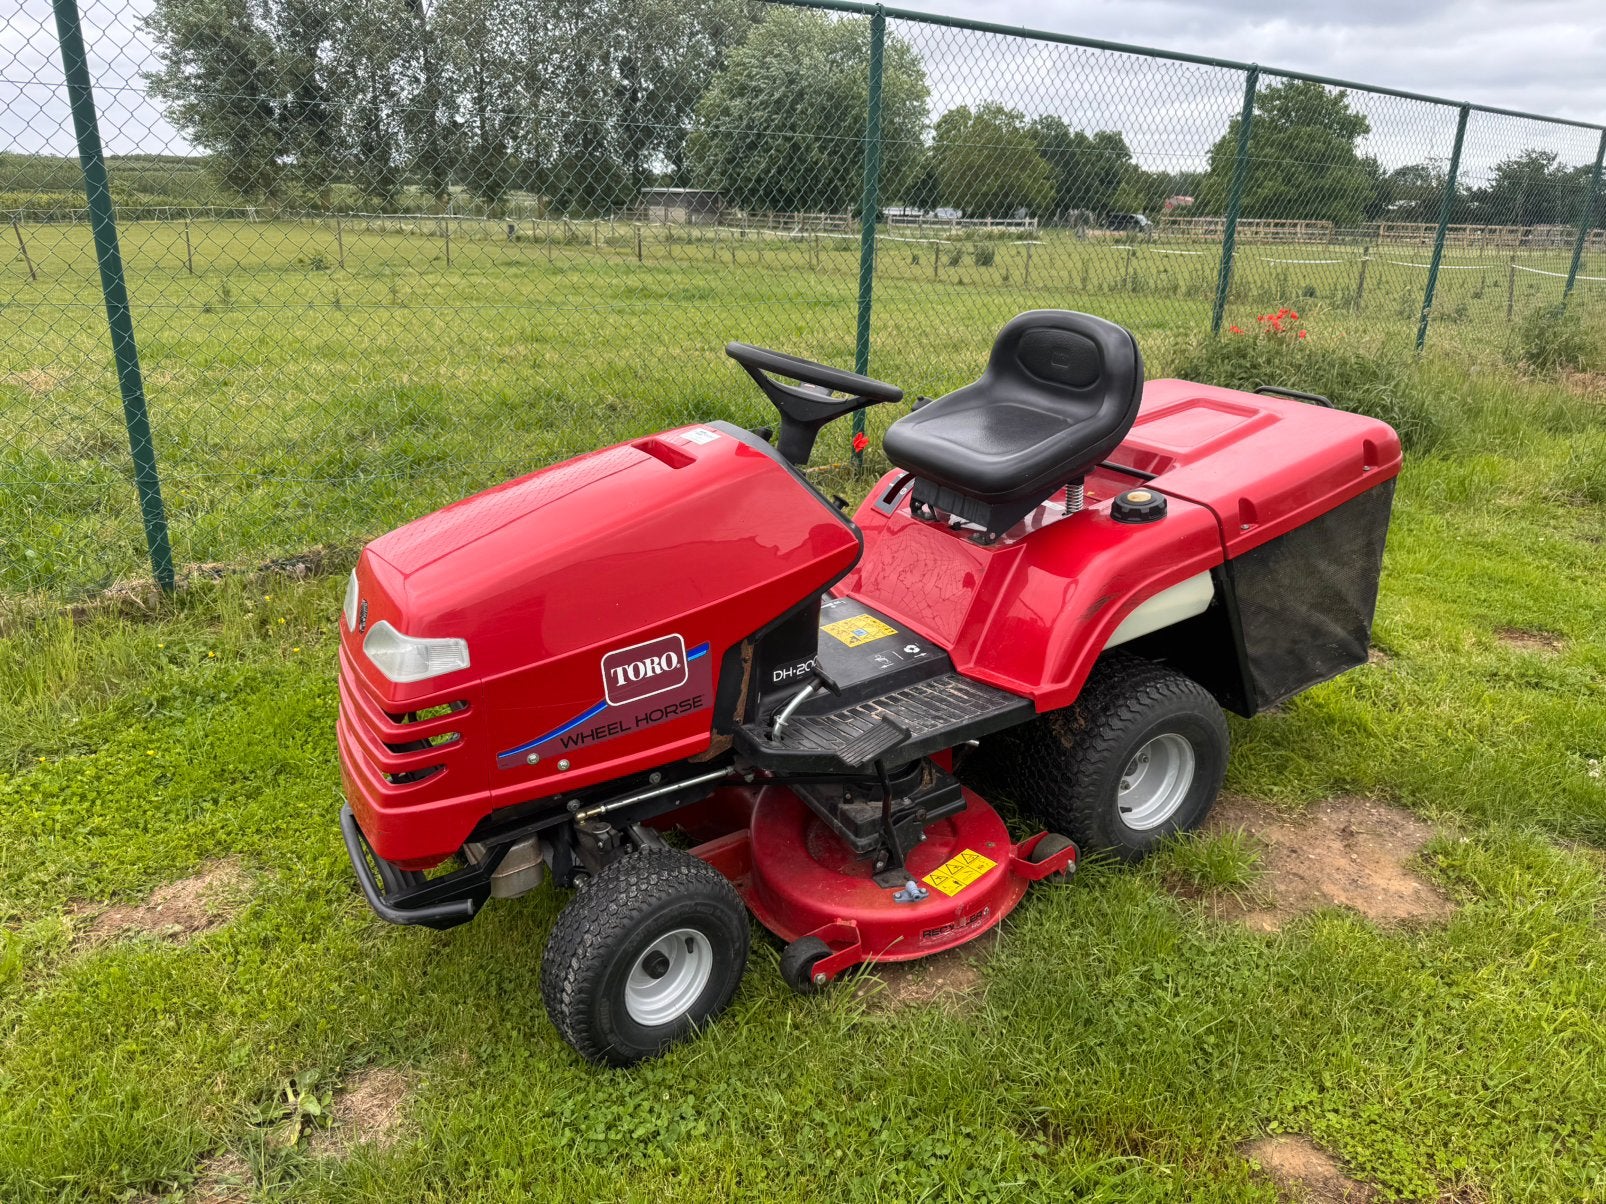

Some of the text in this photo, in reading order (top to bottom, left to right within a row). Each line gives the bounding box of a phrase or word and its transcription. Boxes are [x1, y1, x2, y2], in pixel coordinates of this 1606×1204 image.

[611, 652, 679, 686] TORO
[560, 695, 703, 749] WHEEL HORSE
